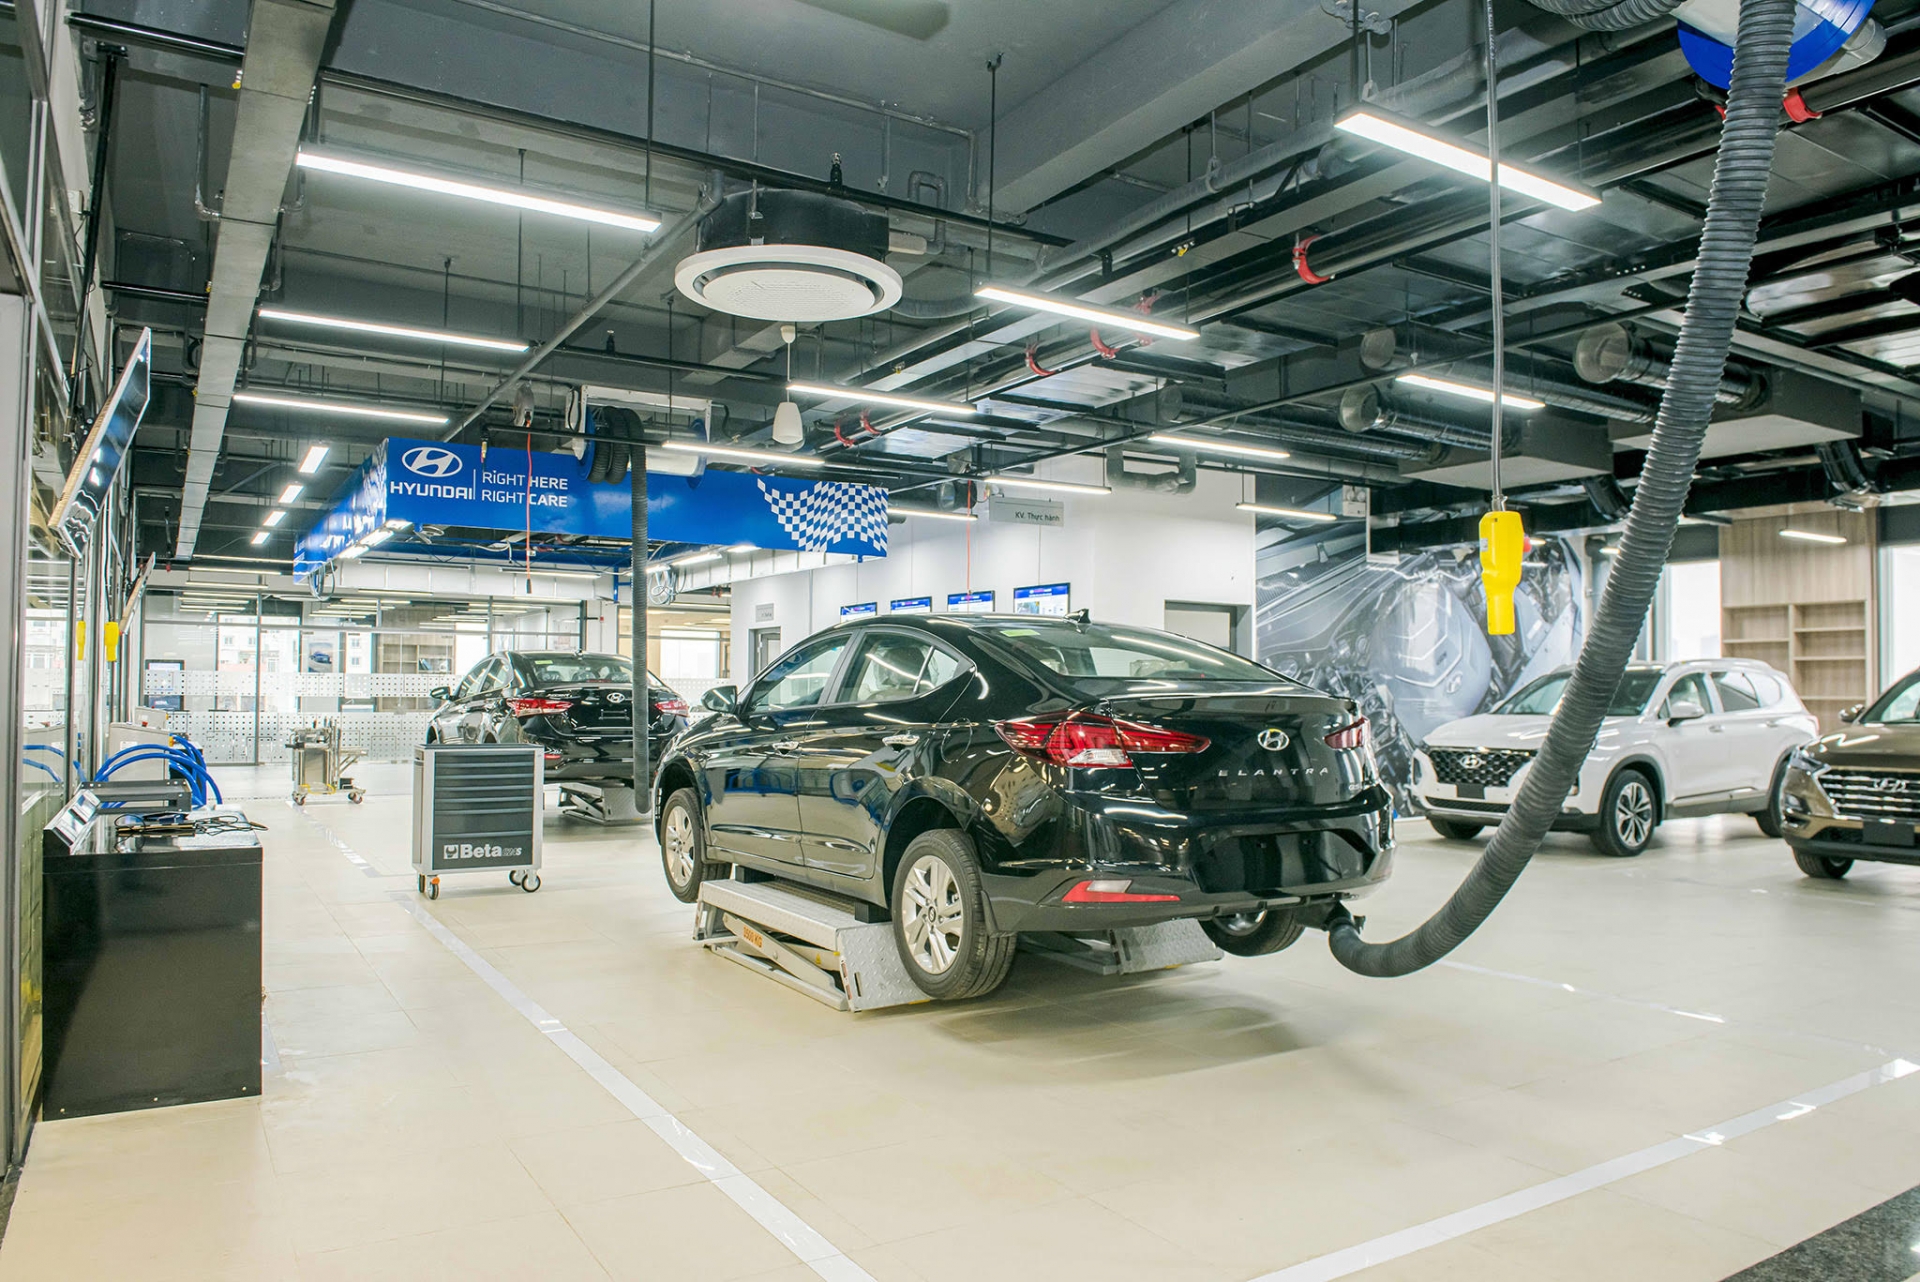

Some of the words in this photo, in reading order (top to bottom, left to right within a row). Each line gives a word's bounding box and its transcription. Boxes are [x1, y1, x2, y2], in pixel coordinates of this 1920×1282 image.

[390, 481, 473, 500] HYUNDAI
[530, 476, 568, 490] HERE
[481, 490, 525, 504] RIGHT
[529, 493, 568, 507] CARE
[1218, 767, 1329, 777] ELANTRA
[460, 844, 502, 859] Beta
